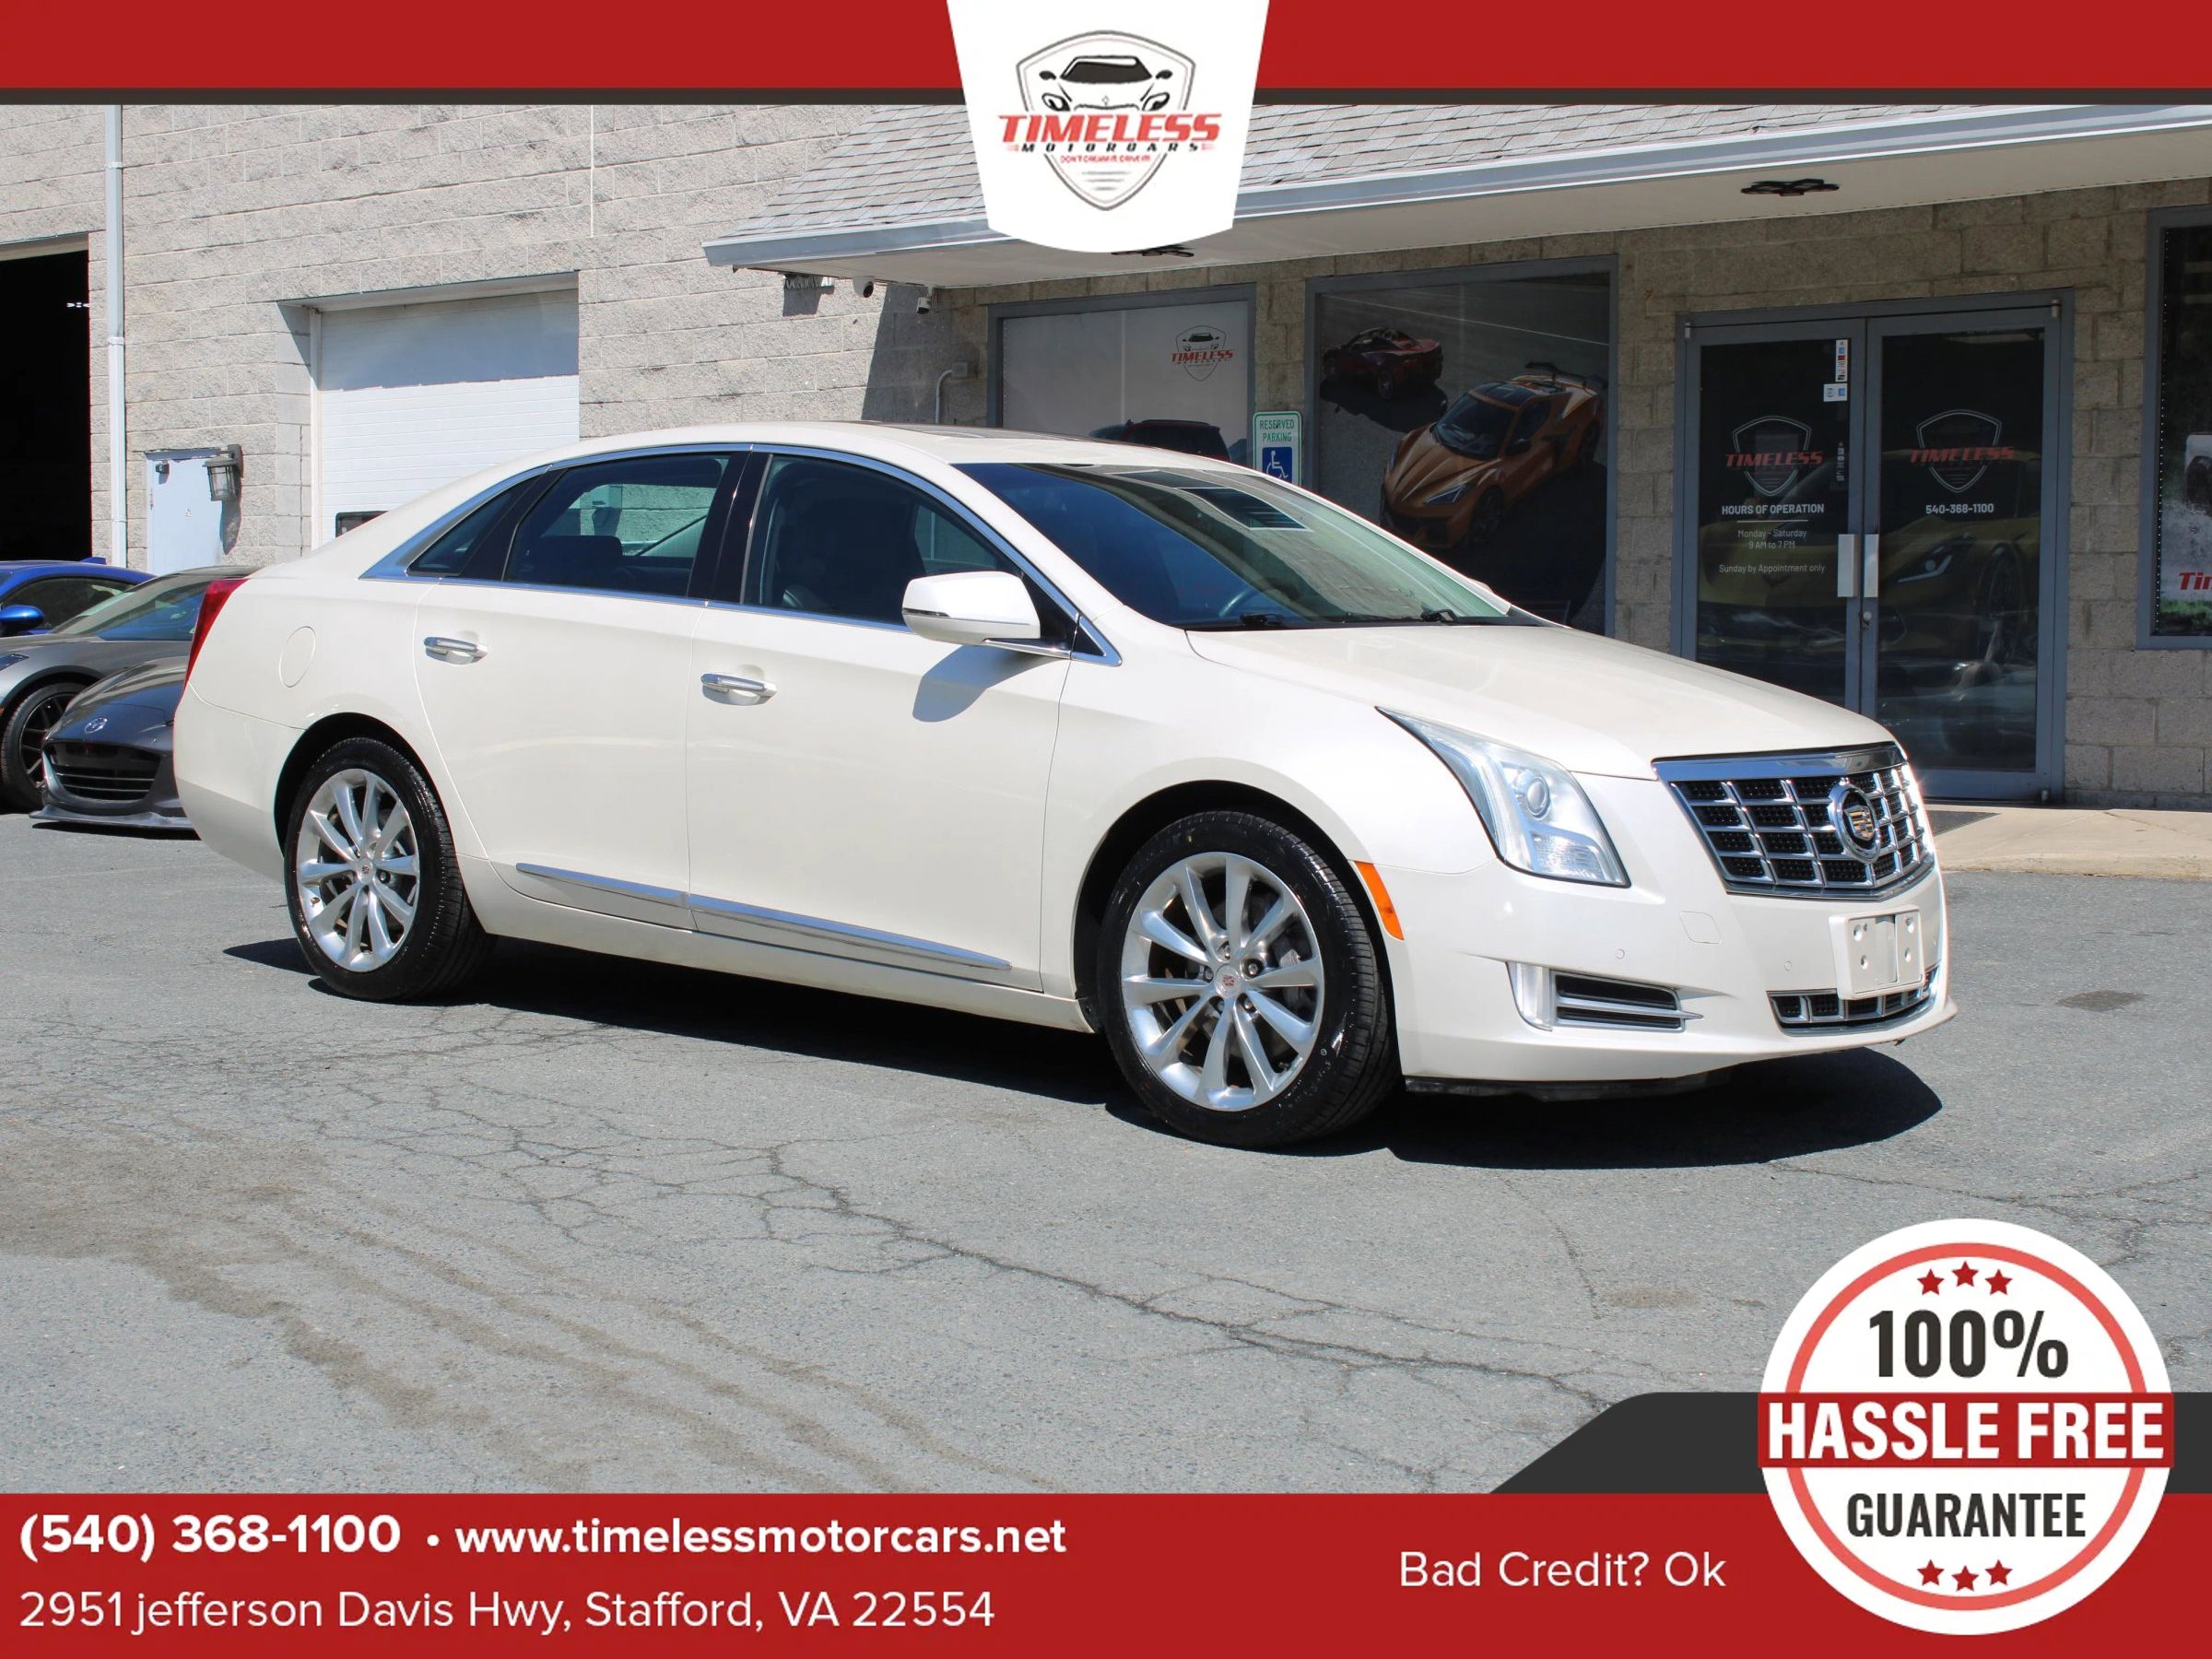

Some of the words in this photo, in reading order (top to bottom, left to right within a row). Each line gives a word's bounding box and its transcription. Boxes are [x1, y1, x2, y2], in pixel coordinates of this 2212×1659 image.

[1171, 350, 1233, 362] TIMELESS
[1259, 419, 1295, 429] RESERVED
[1263, 432, 1292, 442] PARKING
[1725, 451, 1823, 467] TIMELESS
[1911, 447, 2016, 463] TIMELESS
[1722, 505, 1754, 515] HOURS
[1755, 504, 1769, 514] OF
[1770, 503, 1825, 514] OPERATION
[1737, 530, 1767, 539] Monday
[1773, 529, 1807, 539] Saturday
[1755, 541, 1767, 549] AM
[1783, 540, 1795, 549] PM
[1719, 564, 1747, 573] Sunday
[1747, 564, 1757, 573] by
[1758, 564, 1806, 573] Appointment
[1808, 563, 1826, 573] only
